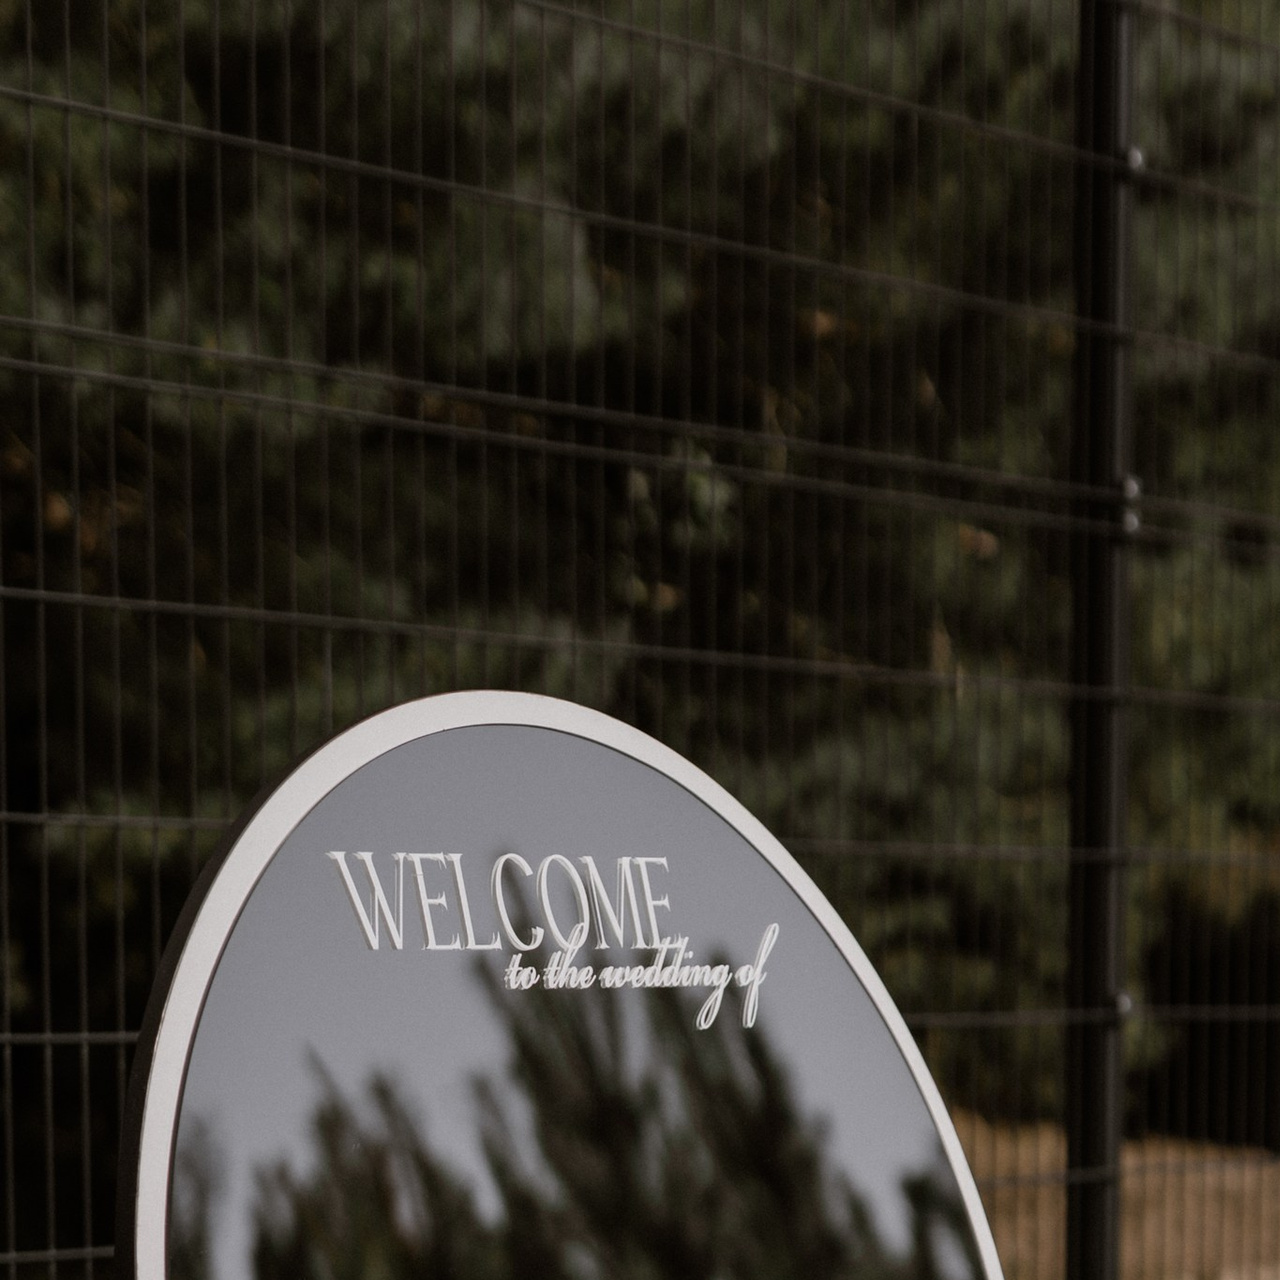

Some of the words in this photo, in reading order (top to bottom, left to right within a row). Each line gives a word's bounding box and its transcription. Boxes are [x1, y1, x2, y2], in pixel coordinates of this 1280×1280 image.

[325, 850, 683, 950] WELCOME
[505, 953, 540, 989] to
[543, 922, 597, 989] the
[599, 936, 732, 1030] wedding
[735, 923, 780, 1028] of
